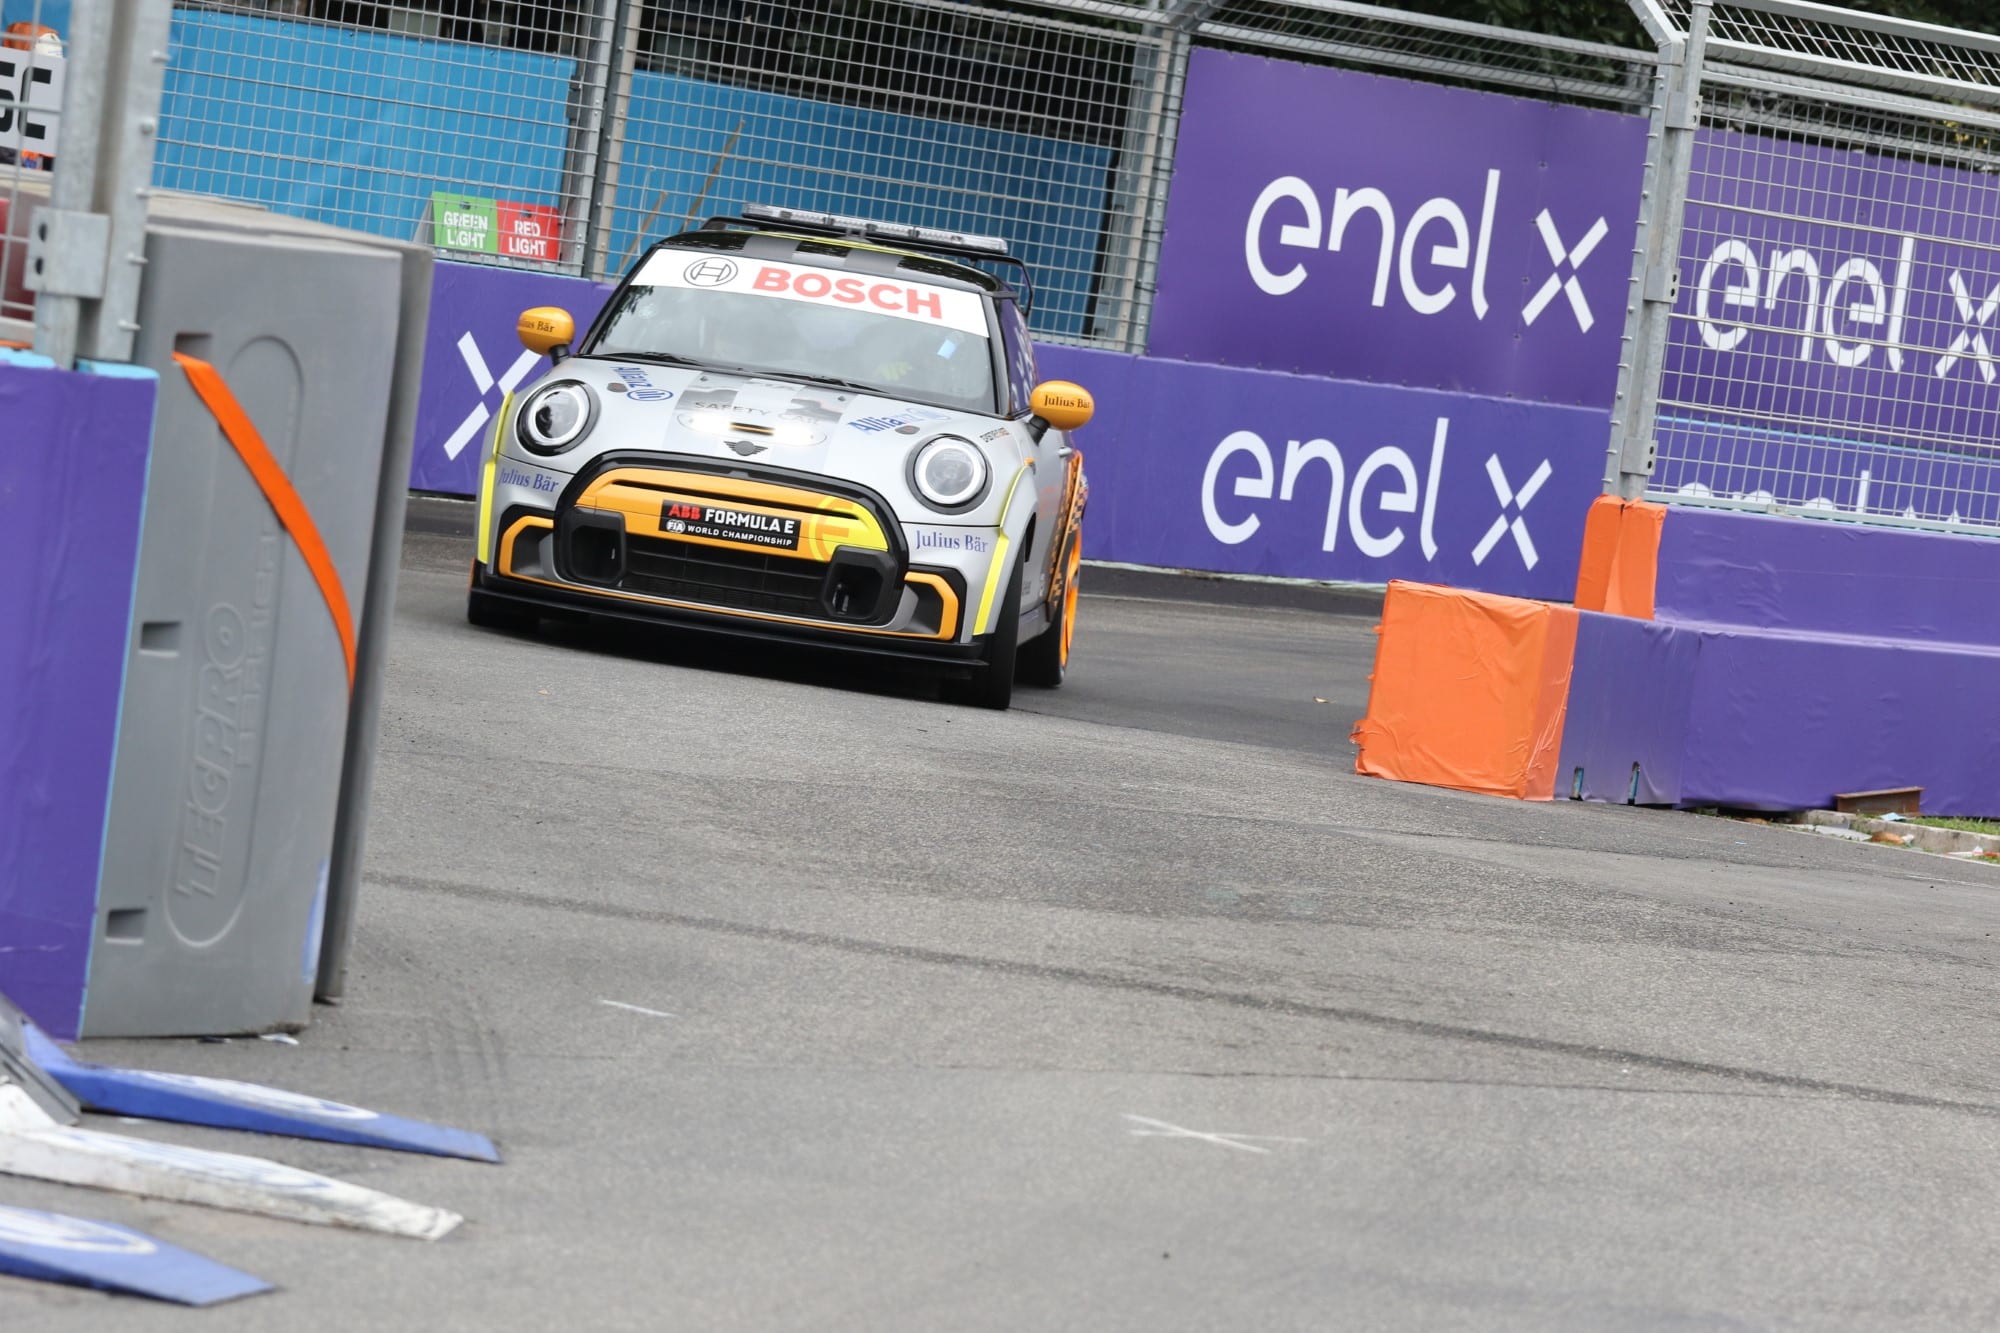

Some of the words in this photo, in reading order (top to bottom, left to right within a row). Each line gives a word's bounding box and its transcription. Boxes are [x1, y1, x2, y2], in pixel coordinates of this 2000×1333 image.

[443, 210, 488, 231] GREEN
[514, 219, 541, 238] RED
[447, 229, 486, 250] LIGHT
[508, 237, 547, 257] LIGHT
[1245, 168, 1500, 321] enel
[752, 266, 943, 320] BOSCH
[1696, 233, 1914, 374] enel
[1044, 394, 1075, 408] Julius
[498, 467, 531, 487] Julius
[533, 473, 559, 492] Bär
[1202, 417, 1449, 562] enel
[668, 503, 701, 520] ABB
[705, 508, 781, 532] FORMULA
[784, 520, 795, 534] E
[687, 524, 720, 536] WORLD
[722, 530, 793, 546] CHAMPIONSHIP
[916, 530, 960, 549] Julius
[965, 534, 988, 552] Bär
